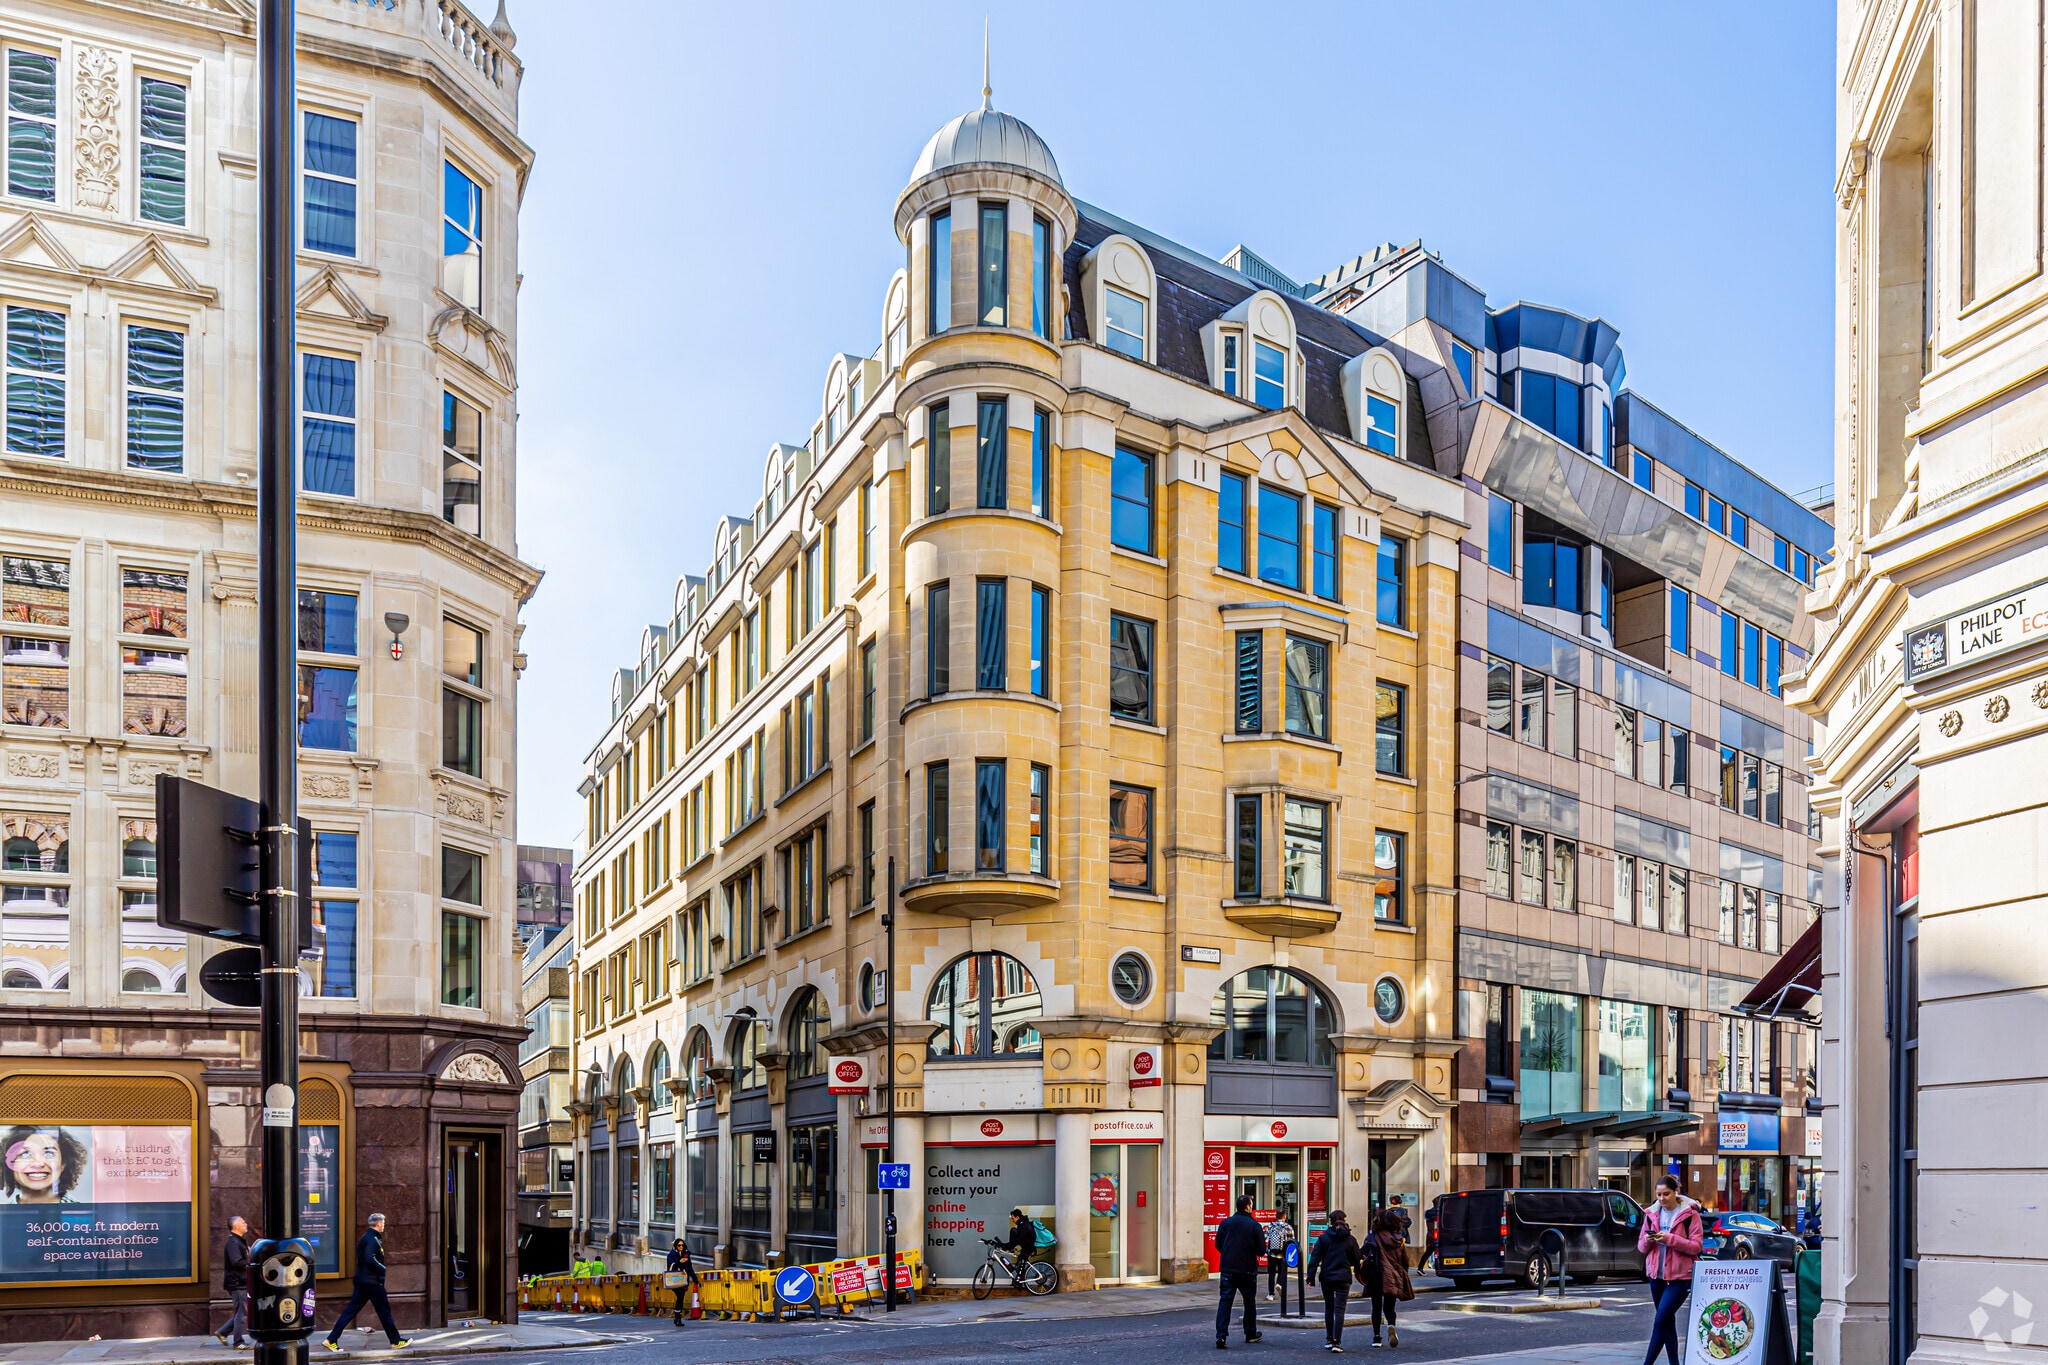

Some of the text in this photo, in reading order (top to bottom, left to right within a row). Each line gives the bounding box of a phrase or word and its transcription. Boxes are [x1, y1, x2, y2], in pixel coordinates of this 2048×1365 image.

[1961, 598, 2026, 635] PHILPOT
[1962, 628, 2003, 654] LANE
[1928, 658, 1946, 669] LONDON
[1094, 1121, 1153, 1131] postoffice.co.uk
[1808, 1130, 1822, 1140] TES
[115, 1145, 170, 1154] A building
[165, 1157, 182, 1167] get
[107, 1169, 178, 1177] excited about
[928, 1165, 1000, 1178] Collect and
[1350, 1168, 1360, 1182] 10
[1430, 1169, 1440, 1182] 10
[928, 1185, 998, 1198] return your
[928, 1200, 966, 1212] online
[26, 1221, 159, 1236] 36,000 sq. ft modern
[928, 1217, 985, 1232] shopping
[27, 1235, 158, 1247] self-contained office
[928, 1234, 955, 1246] here
[44, 1249, 143, 1262] space available
[834, 1268, 862, 1278] PEDESTRIANS
